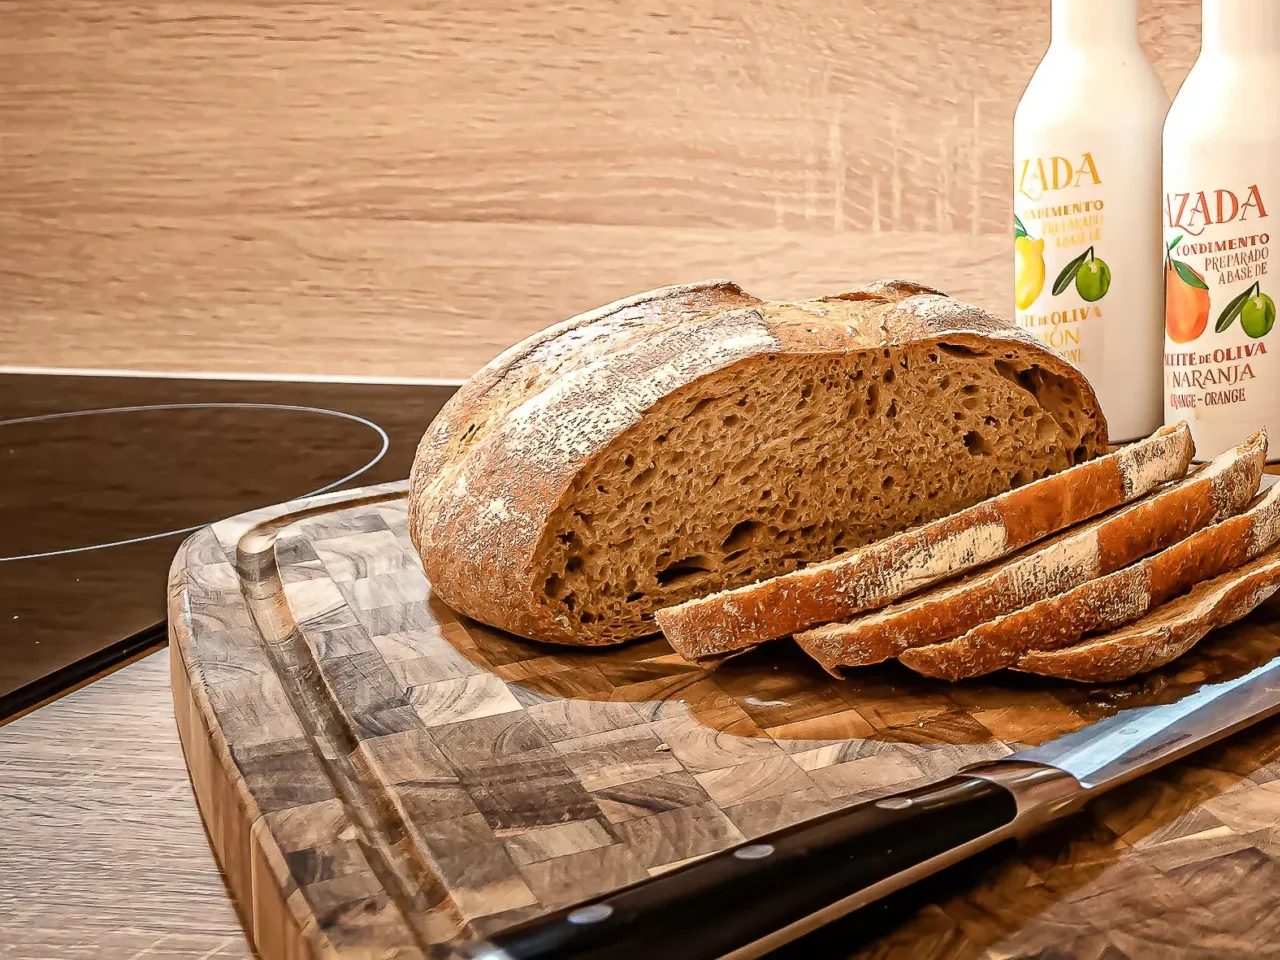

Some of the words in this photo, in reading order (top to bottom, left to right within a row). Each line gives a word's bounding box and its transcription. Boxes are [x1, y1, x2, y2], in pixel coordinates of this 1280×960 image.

[1176, 233, 1270, 257] CONDIMENTO
[1205, 246, 1269, 273] PREPARADO
[1226, 265, 1253, 284] BASE
[1255, 261, 1268, 278] DE
[1050, 305, 1103, 326] OLIVA
[1198, 353, 1212, 365] DE
[1213, 341, 1268, 363] OLIVA
[1172, 362, 1256, 390] NARANJA
[1204, 387, 1247, 407] ORANGE
